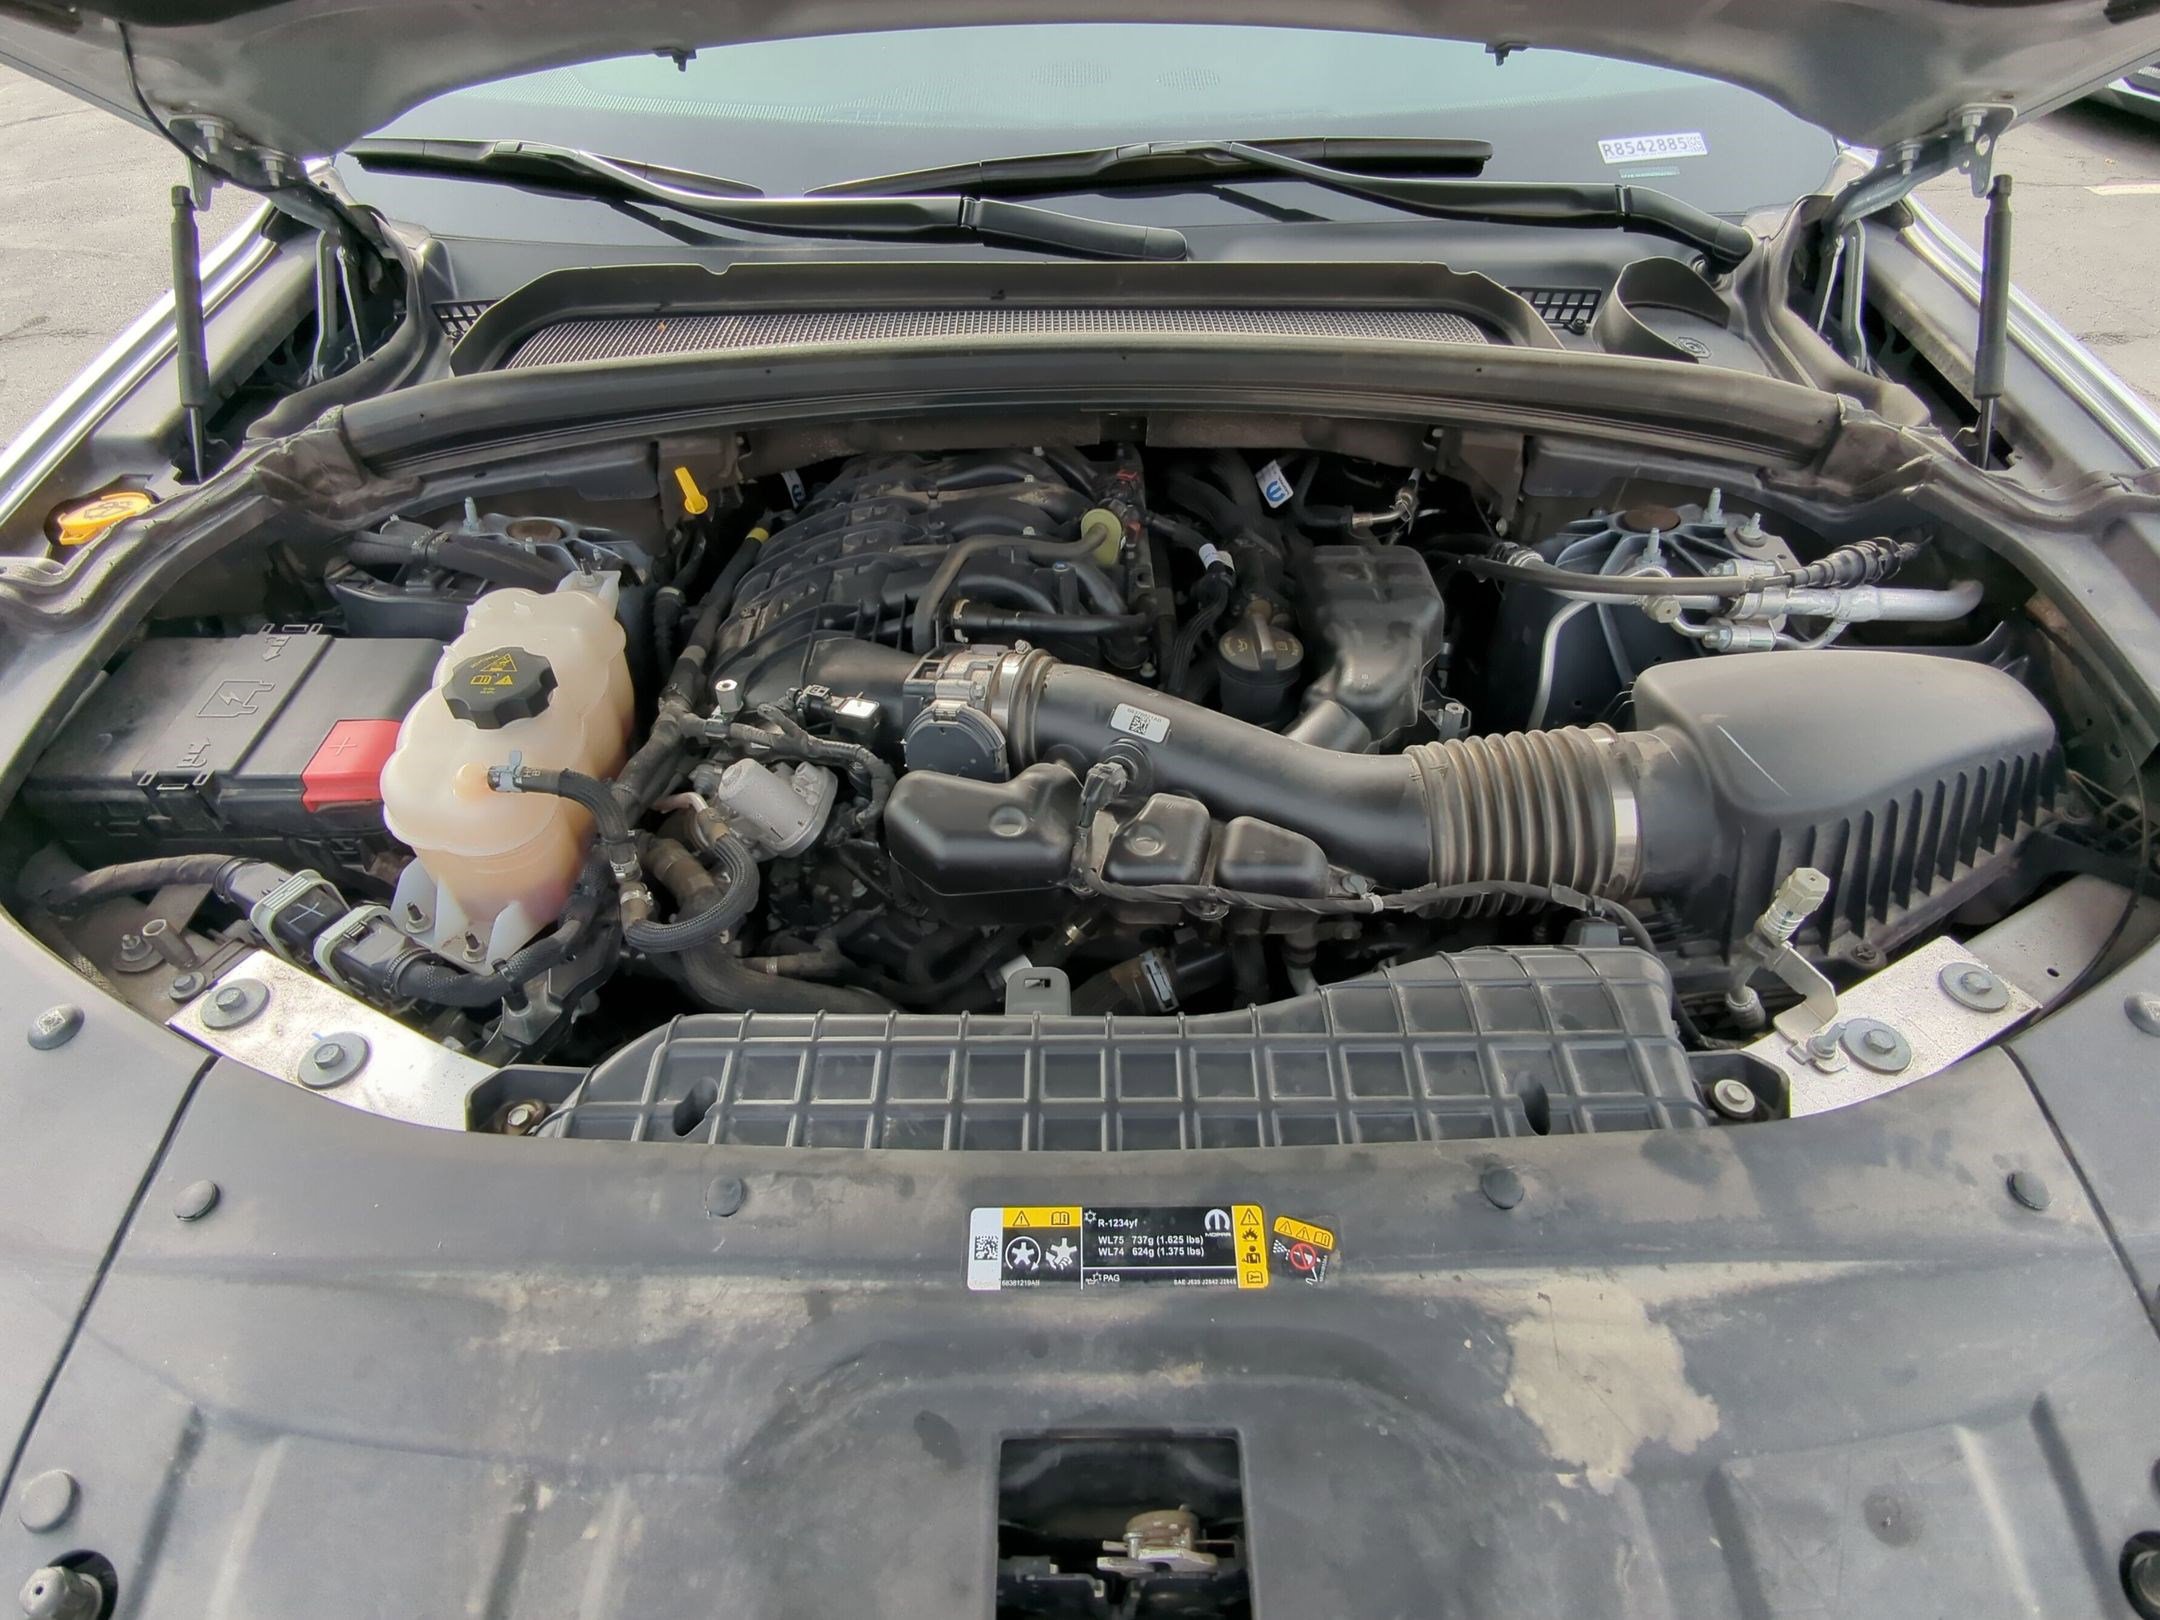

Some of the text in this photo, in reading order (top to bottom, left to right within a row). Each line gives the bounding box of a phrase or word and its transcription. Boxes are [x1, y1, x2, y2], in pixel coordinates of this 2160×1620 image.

[1602, 137, 1688, 156] R8542885
[1098, 1218, 1138, 1229] R-1234yf
[1098, 1235, 1204, 1246] WL75 737g (1.625 lbs)
[1098, 1247, 1205, 1258] WL74 624g (1.375 lbs)
[1103, 1274, 1120, 1282] PAG
